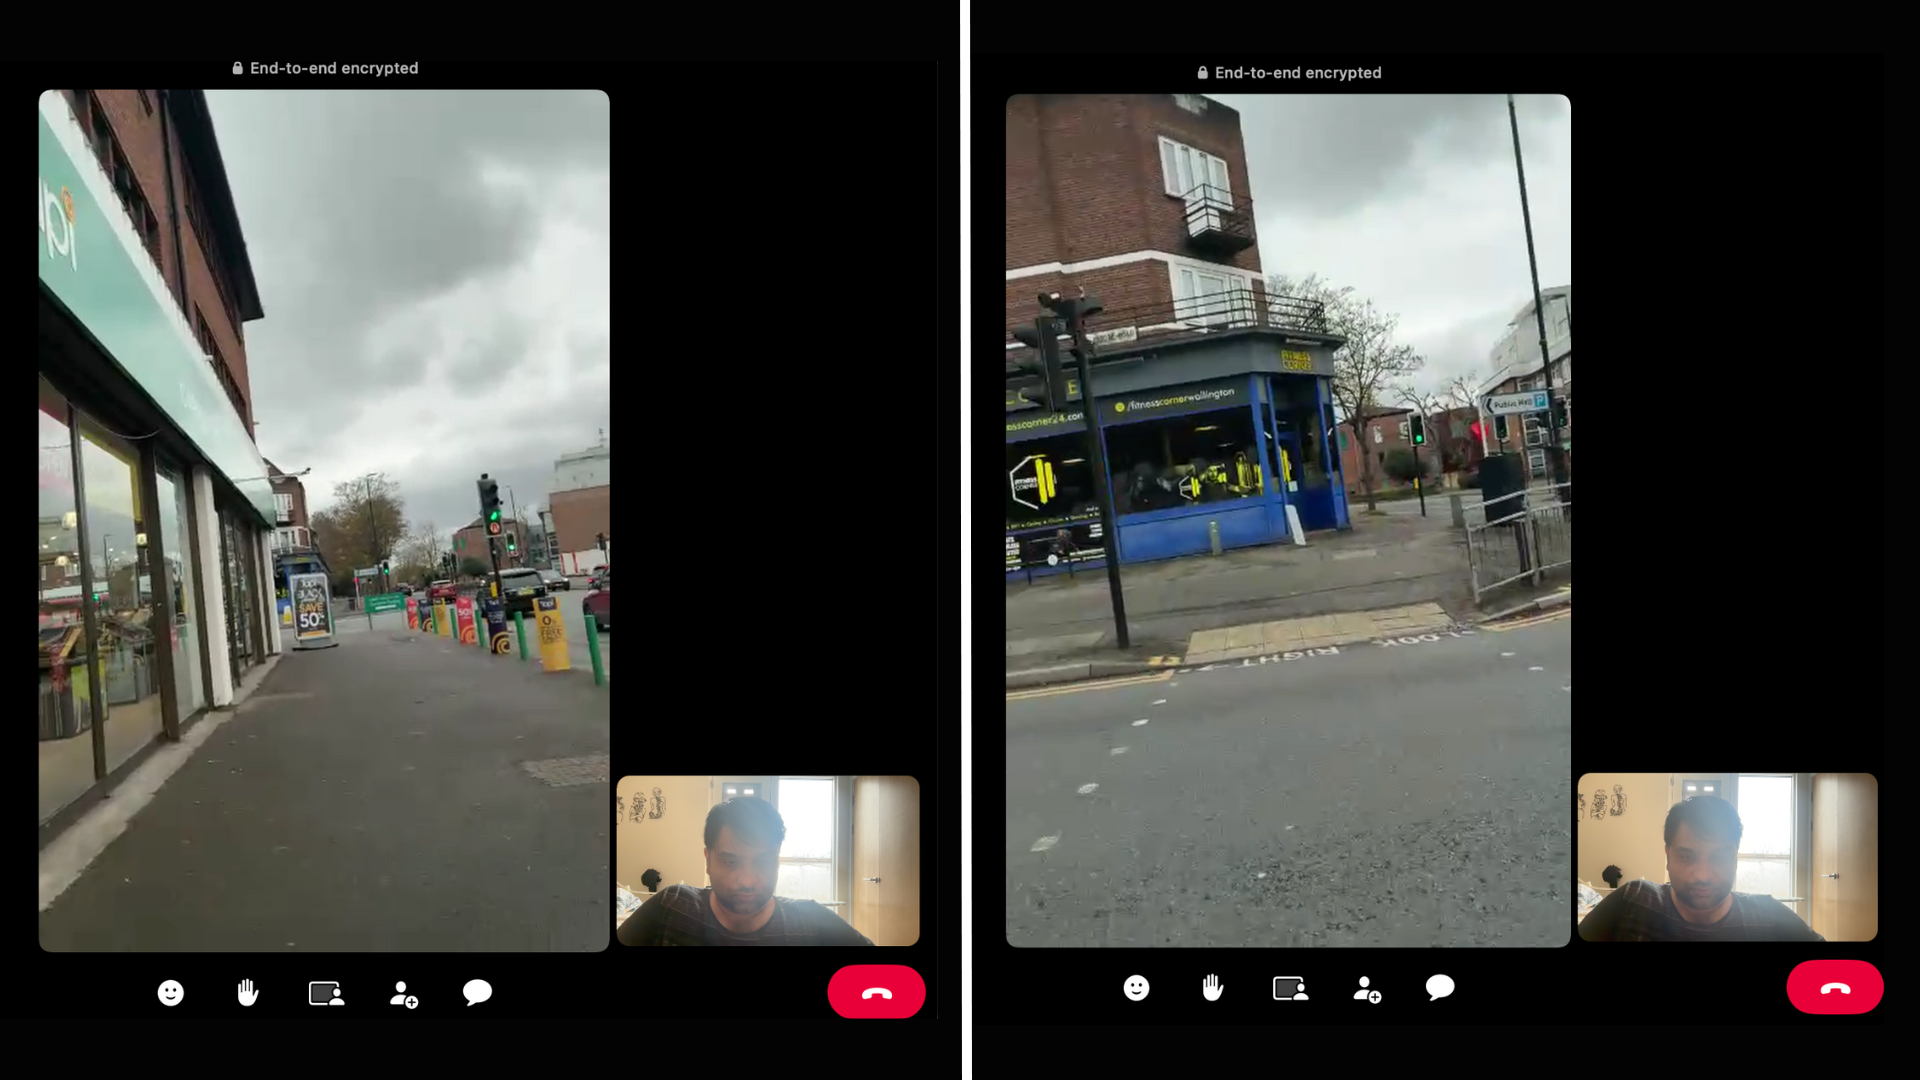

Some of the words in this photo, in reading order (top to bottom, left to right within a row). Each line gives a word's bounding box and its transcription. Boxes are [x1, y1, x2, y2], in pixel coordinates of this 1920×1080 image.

[250, 61, 337, 75] End-to-end
[341, 61, 419, 77] encrypted
[1215, 66, 1301, 80] End-to-end
[1305, 66, 1382, 82] encrypted
[299, 603, 324, 613] SAVE
[1236, 646, 1340, 668] RIGHT
